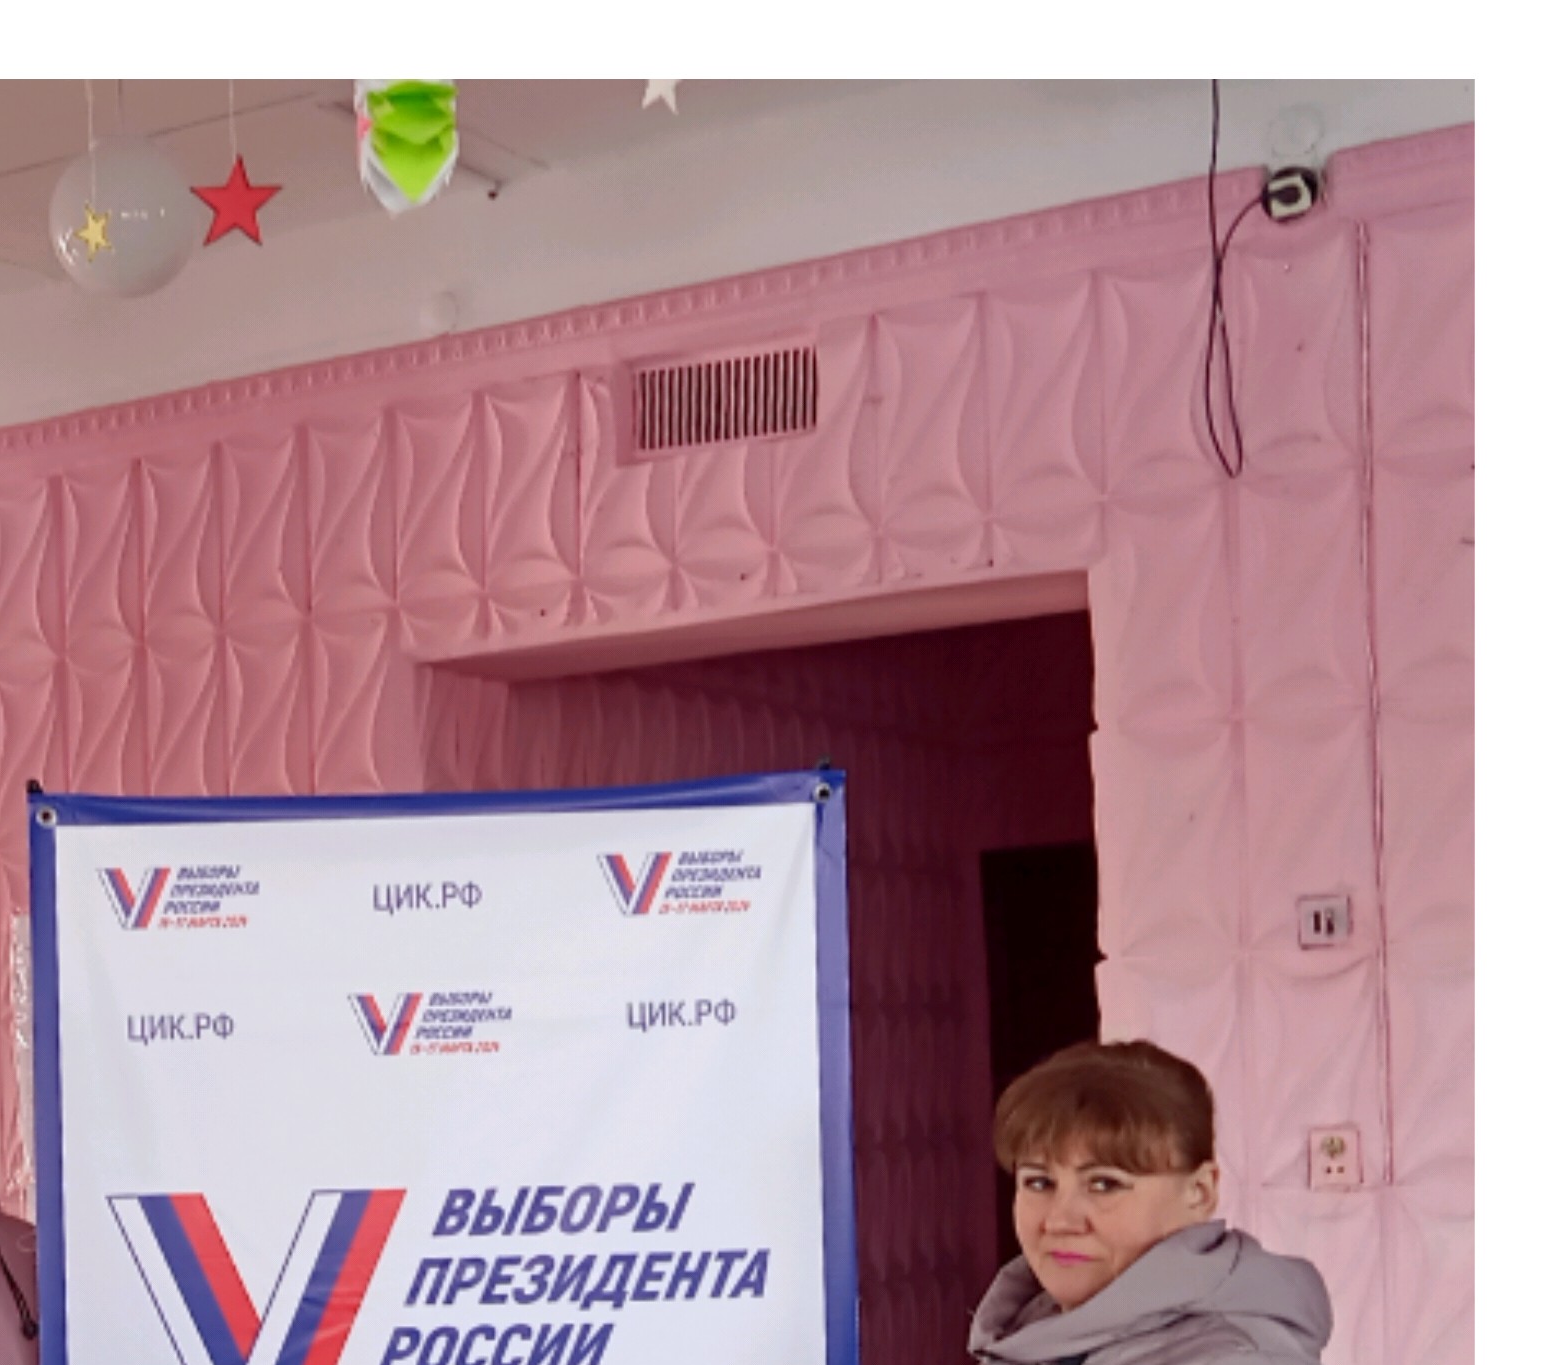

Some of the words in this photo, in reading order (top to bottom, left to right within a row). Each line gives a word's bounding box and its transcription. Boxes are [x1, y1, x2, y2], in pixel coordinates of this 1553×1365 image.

[373, 881, 482, 913] ЦИК.РФ
[127, 1013, 234, 1042] ЦИК.РФ
[626, 998, 736, 1031] ЦИК.РФ
[432, 1182, 696, 1236] ВЫБОРЫ
[404, 1248, 771, 1310] ПРЕЗИДЕНТА
